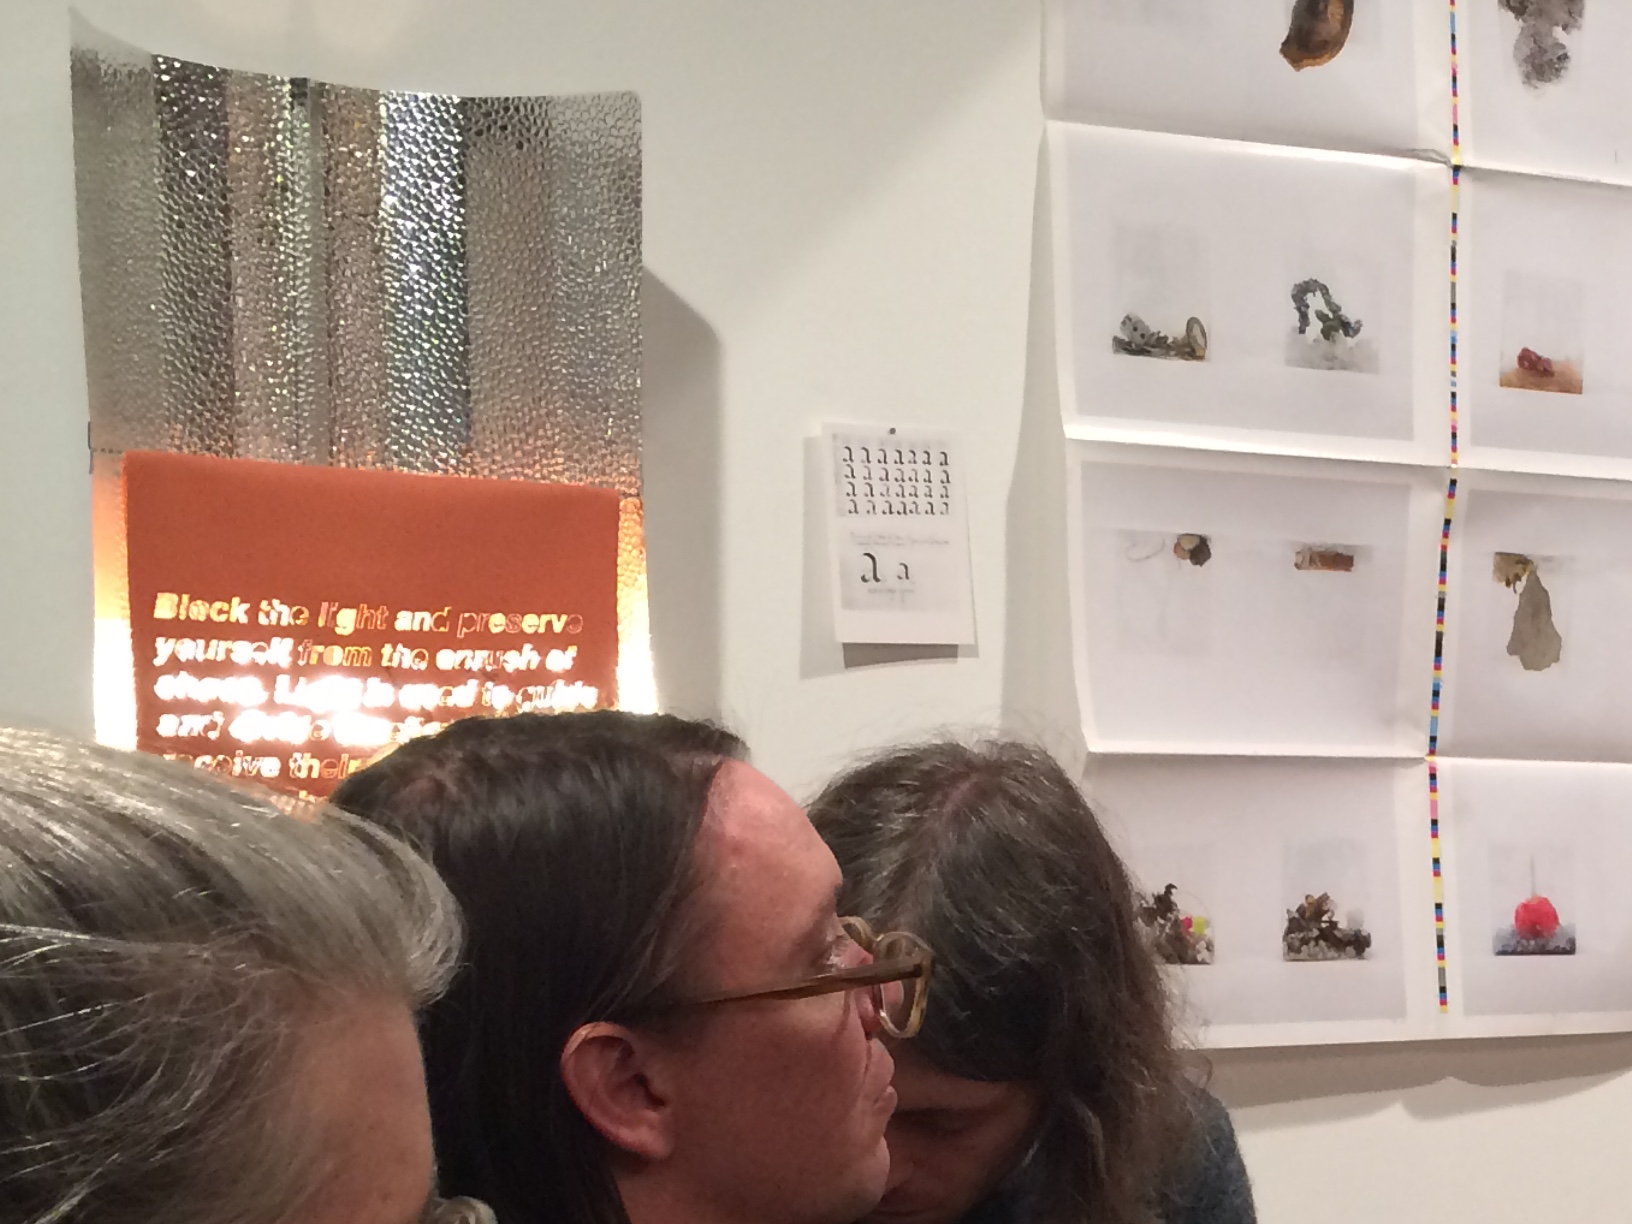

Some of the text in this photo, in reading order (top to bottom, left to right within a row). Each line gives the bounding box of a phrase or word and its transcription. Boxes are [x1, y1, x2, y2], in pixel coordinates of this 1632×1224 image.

[257, 598, 310, 626] the
[317, 601, 389, 636] light
[394, 606, 452, 632] and
[456, 612, 584, 639] preserve
[153, 636, 294, 669] yourself
[297, 639, 373, 667] from
[380, 643, 429, 671] the
[545, 645, 578, 672] of
